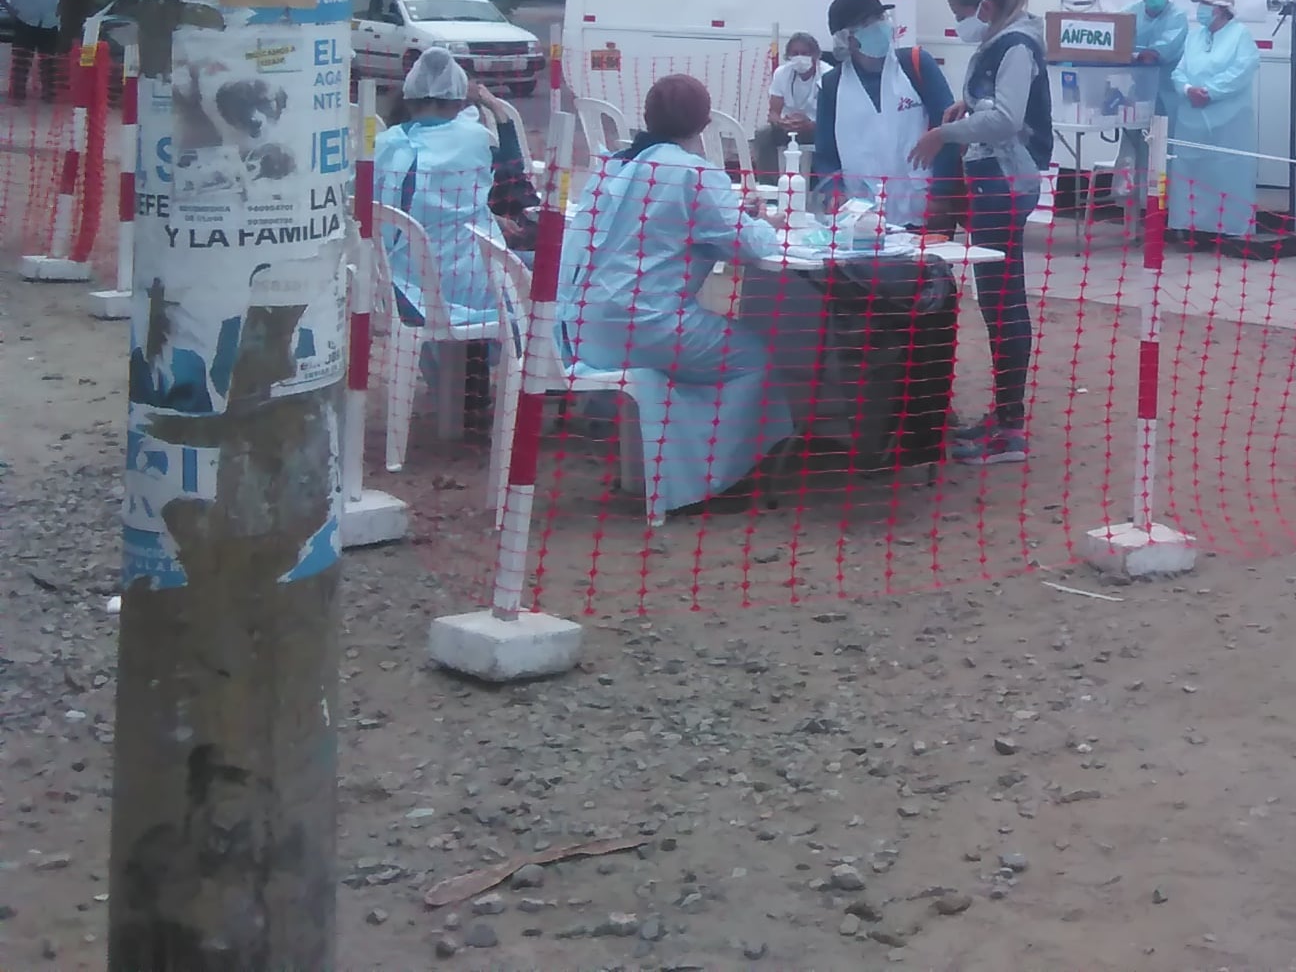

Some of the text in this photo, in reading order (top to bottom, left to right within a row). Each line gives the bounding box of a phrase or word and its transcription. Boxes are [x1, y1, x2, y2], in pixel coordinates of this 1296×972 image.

[1060, 22, 1112, 46] ÁNFORA
[314, 38, 343, 66] EL
[164, 213, 341, 248] Y LA FAMILIA
